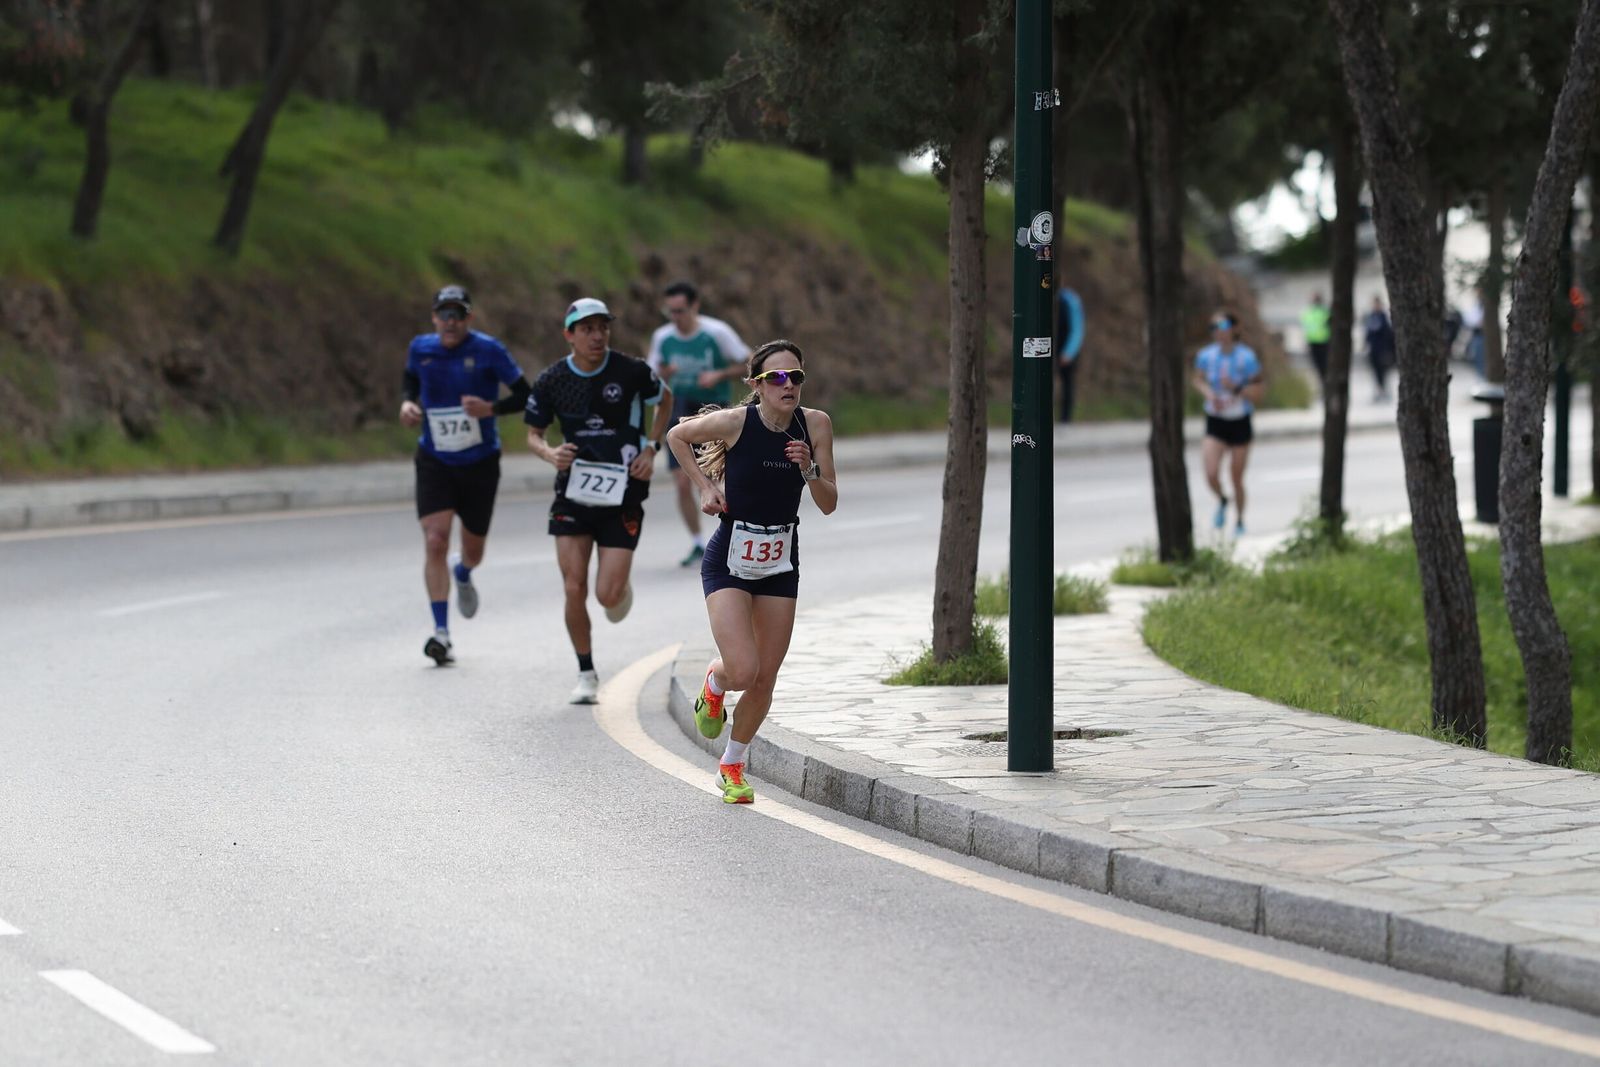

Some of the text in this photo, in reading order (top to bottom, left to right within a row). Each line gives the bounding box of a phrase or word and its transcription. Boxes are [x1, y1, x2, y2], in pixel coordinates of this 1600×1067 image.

[438, 420, 471, 436] 374
[763, 460, 792, 470] OYSHO
[580, 472, 618, 494] 727
[740, 539, 785, 563] 133
